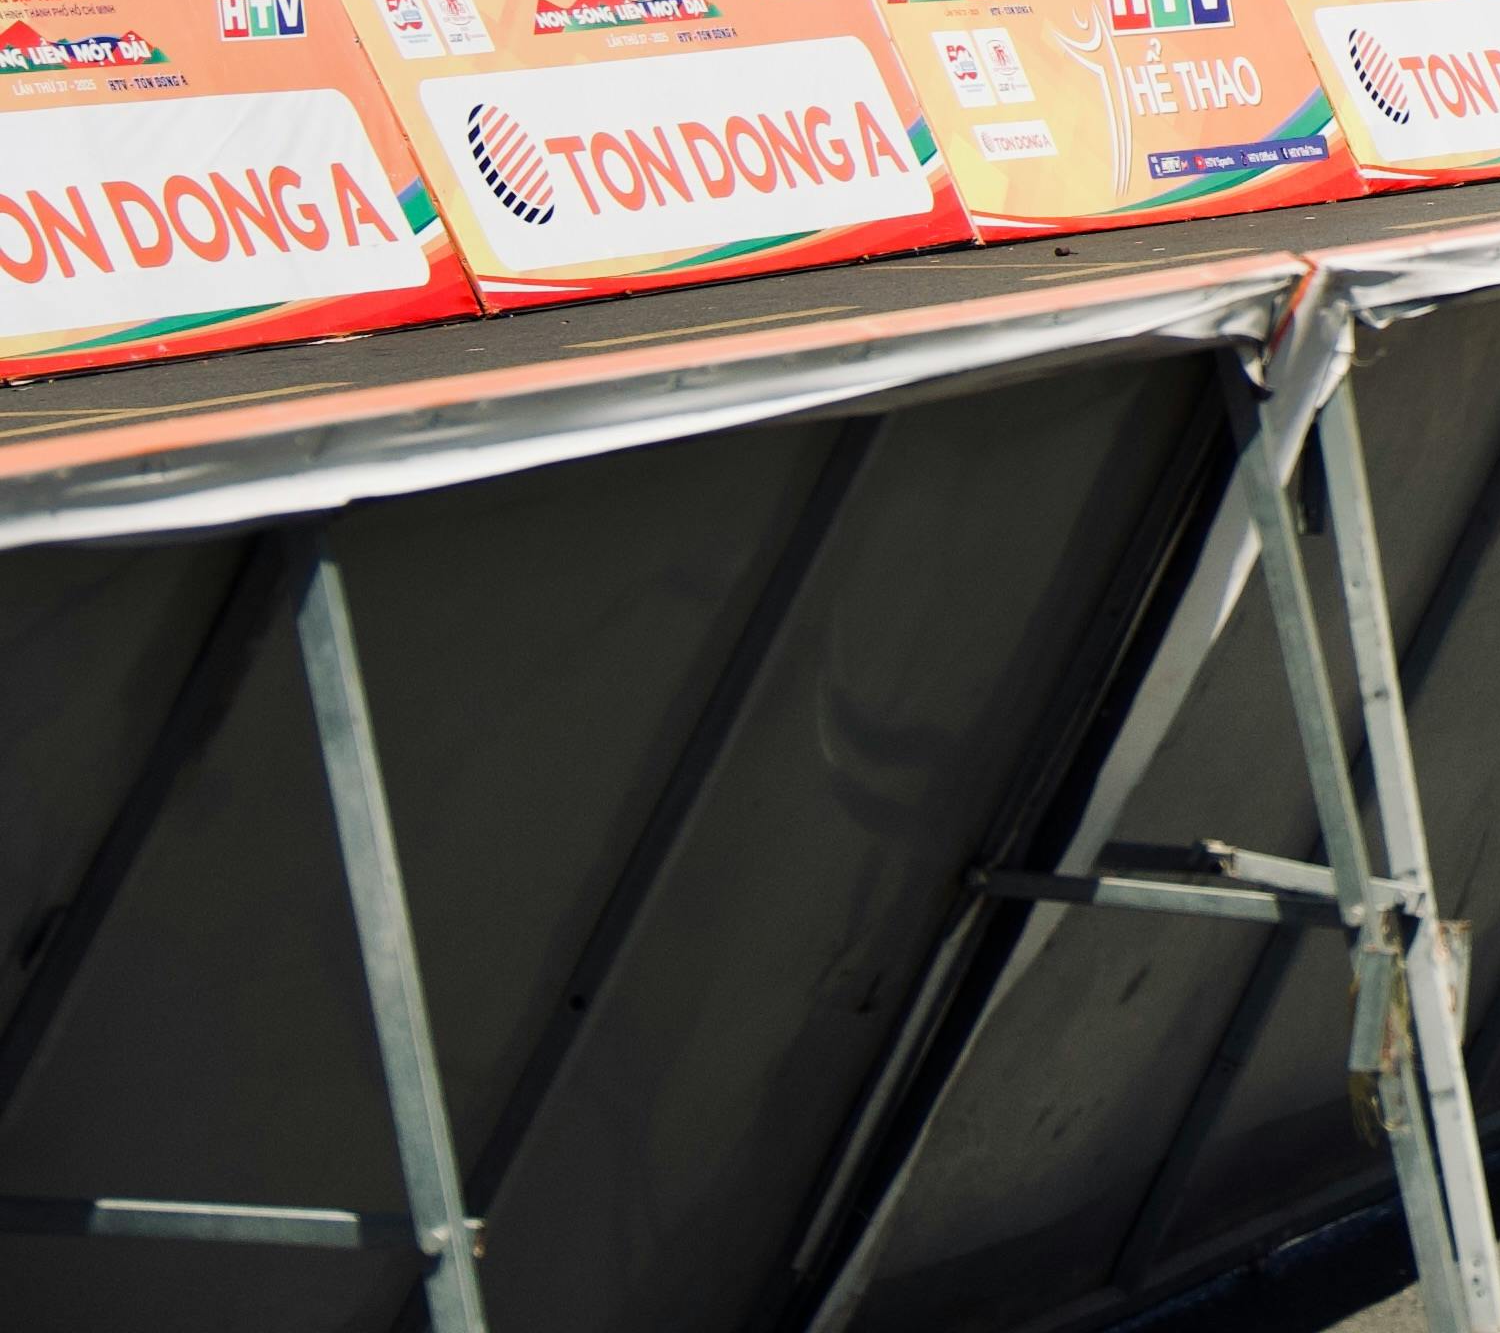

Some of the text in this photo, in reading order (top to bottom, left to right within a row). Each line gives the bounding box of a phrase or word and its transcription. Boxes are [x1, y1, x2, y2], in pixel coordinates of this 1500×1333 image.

[1174, 56, 1262, 111] THAO
[544, 101, 910, 215] TON DONG A
[0, 162, 399, 285] ON DONG A
